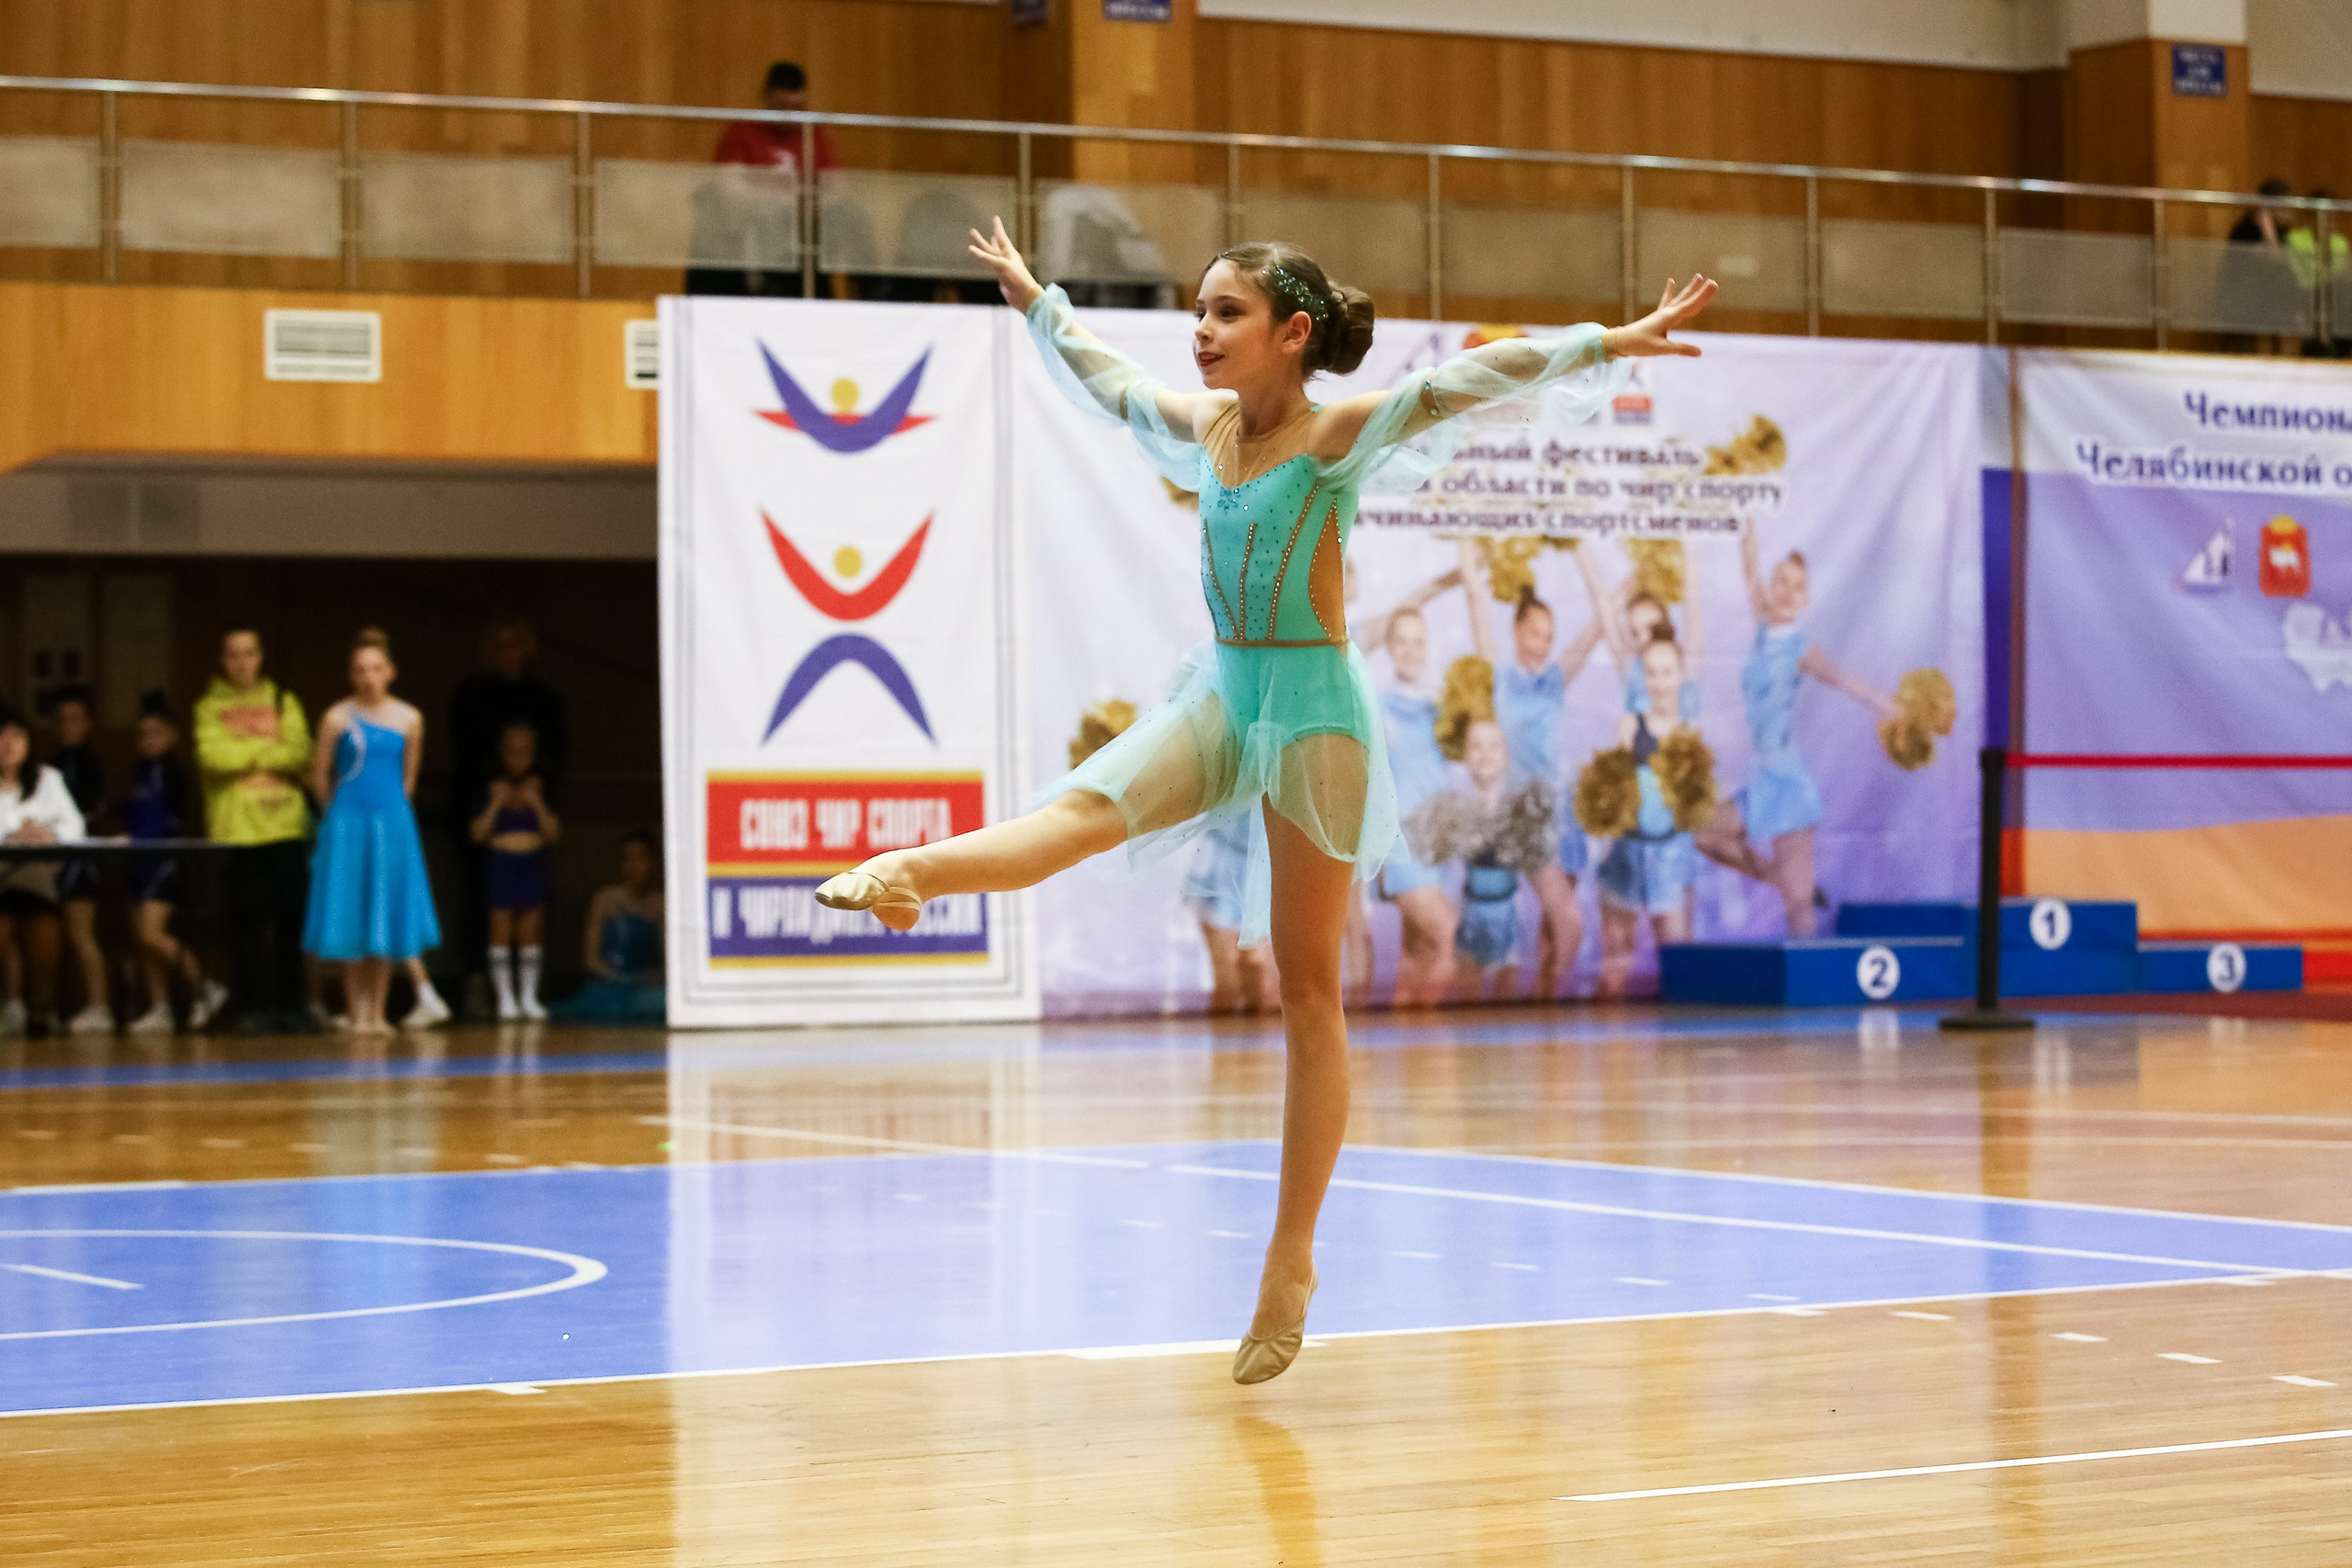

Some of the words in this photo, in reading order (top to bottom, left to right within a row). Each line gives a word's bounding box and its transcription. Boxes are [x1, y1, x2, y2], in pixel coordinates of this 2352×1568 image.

[1541, 439, 1698, 468] фестиваль
[2075, 441, 2322, 486] Челябинской
[1442, 467, 1565, 494] области
[1683, 481, 1781, 507] спорту
[1545, 513, 1738, 538] спортсменов
[2041, 909, 2058, 941] 1
[1867, 954, 1890, 989] 2
[2215, 950, 2237, 983] 3
